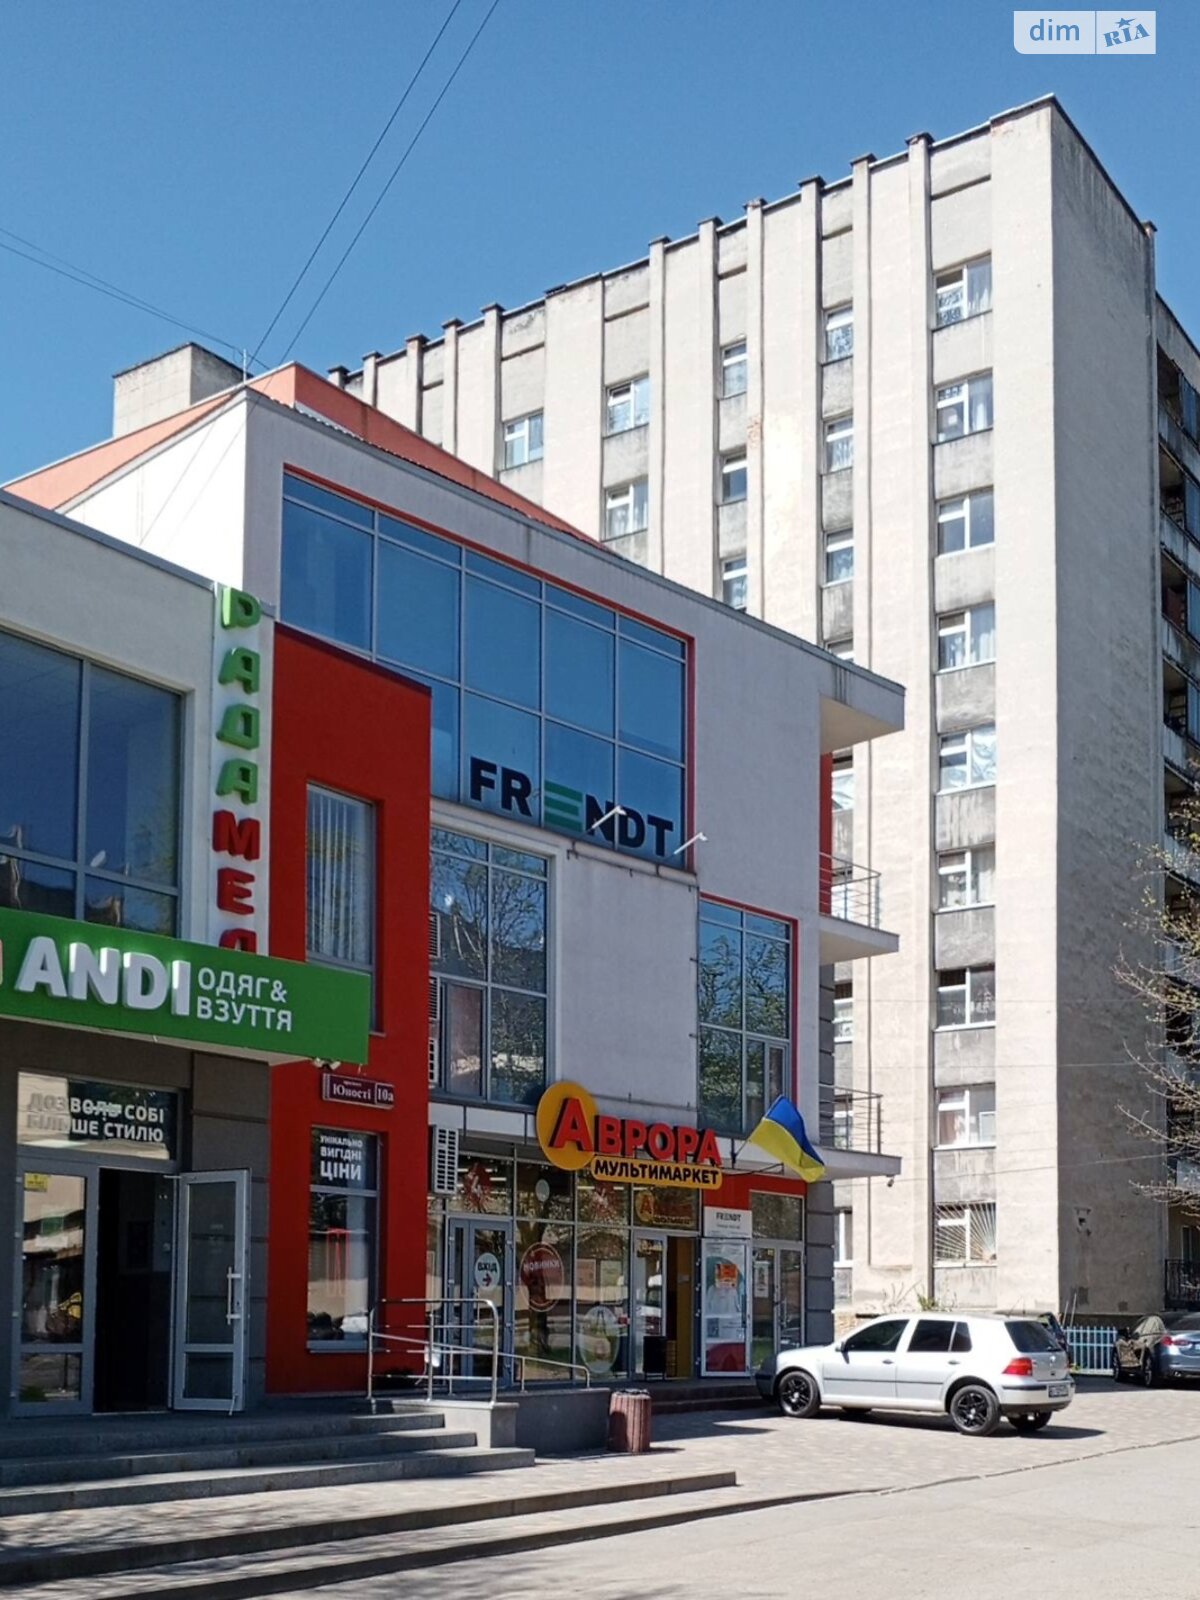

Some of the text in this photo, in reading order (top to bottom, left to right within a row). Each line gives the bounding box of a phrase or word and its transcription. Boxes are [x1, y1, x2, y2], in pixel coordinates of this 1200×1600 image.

[14, 936, 192, 1016] ANDI
[197, 996, 292, 1032] ВЗУТТЯ
[333, 1083, 371, 1100] Юності
[125, 1104, 164, 1123] СОБІ
[104, 1122, 163, 1142] СТИЛЮ
[549, 1098, 722, 1166] АВРОРА
[320, 1146, 361, 1161] ВИГІДНІ
[320, 1160, 361, 1181] ЦІНИ
[594, 1158, 719, 1185] МУЛЬТИМАРКЕТ
